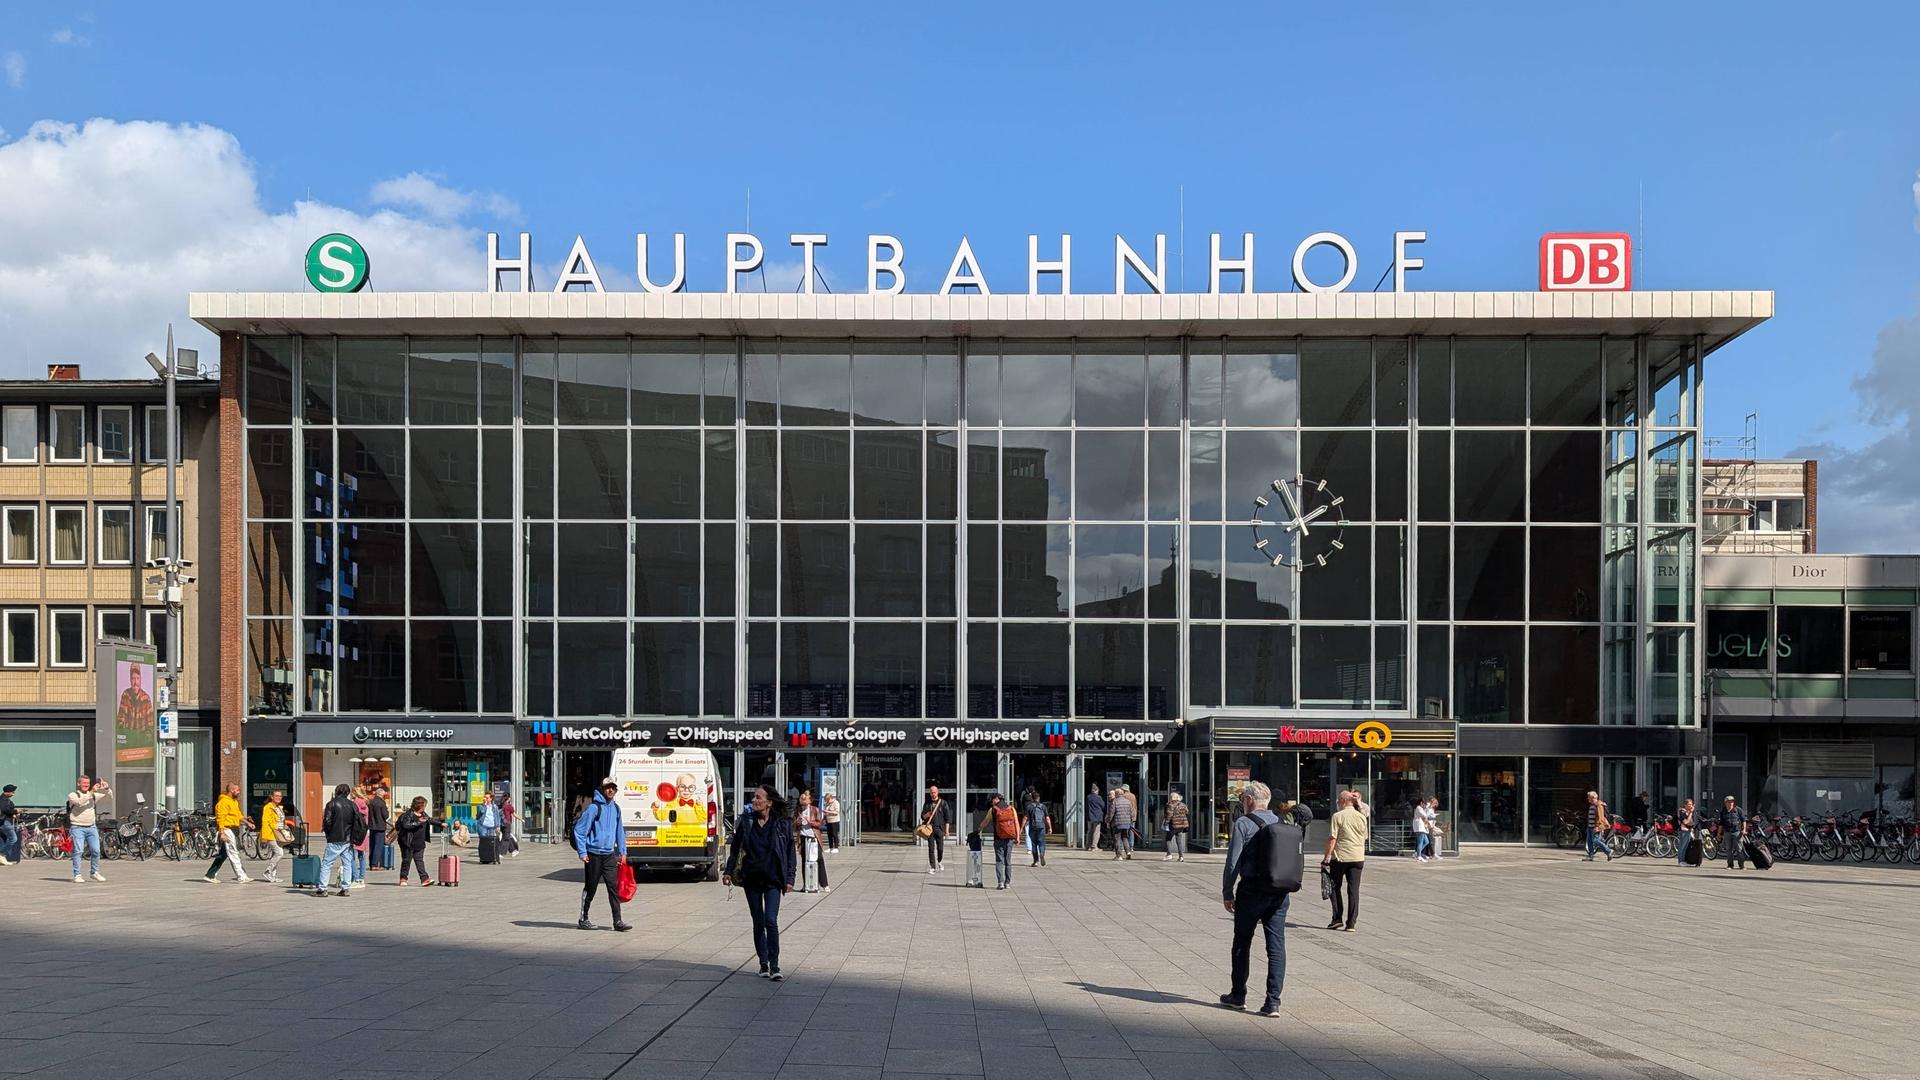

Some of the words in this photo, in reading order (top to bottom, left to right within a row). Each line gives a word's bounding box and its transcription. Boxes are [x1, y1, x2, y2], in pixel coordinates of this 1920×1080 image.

[319, 241, 355, 288] S
[487, 231, 1427, 294] HAUPTBAHNHOF
[1553, 243, 1620, 285] DB
[1792, 565, 1827, 578] Dior
[372, 729, 393, 738] THE
[395, 729, 423, 738] BODY
[425, 729, 454, 738] SHOP
[561, 726, 651, 742] NetCologne
[694, 727, 774, 742] Highspeed
[816, 727, 906, 743] NetCologne
[950, 727, 1029, 743] Highspeed
[1073, 727, 1164, 743] NetCologne
[1280, 725, 1351, 748] Kamps
